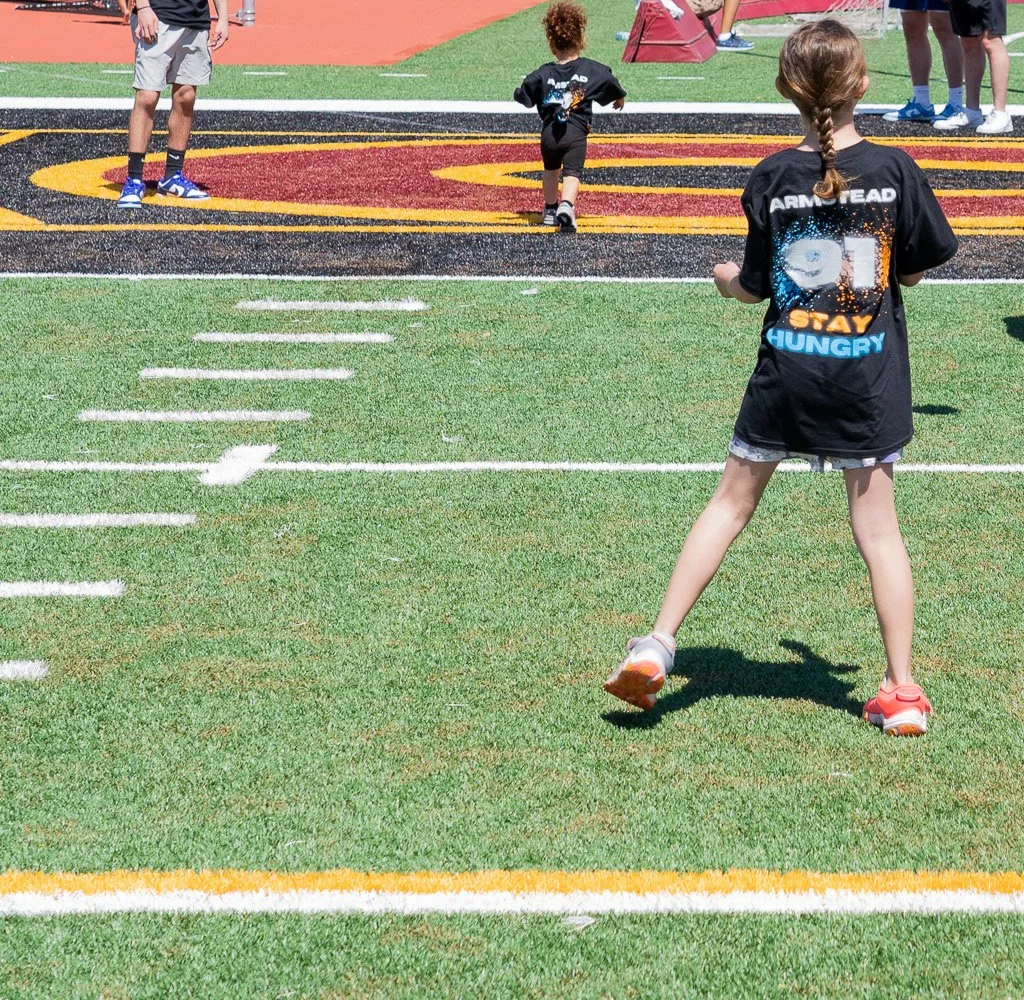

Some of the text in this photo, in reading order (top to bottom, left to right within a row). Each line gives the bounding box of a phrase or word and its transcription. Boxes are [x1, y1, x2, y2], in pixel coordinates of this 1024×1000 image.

[769, 187, 897, 213] ARMTEAD
[785, 236, 877, 290] 91
[789, 309, 873, 333] STAY
[766, 327, 886, 358] HUNGRY
